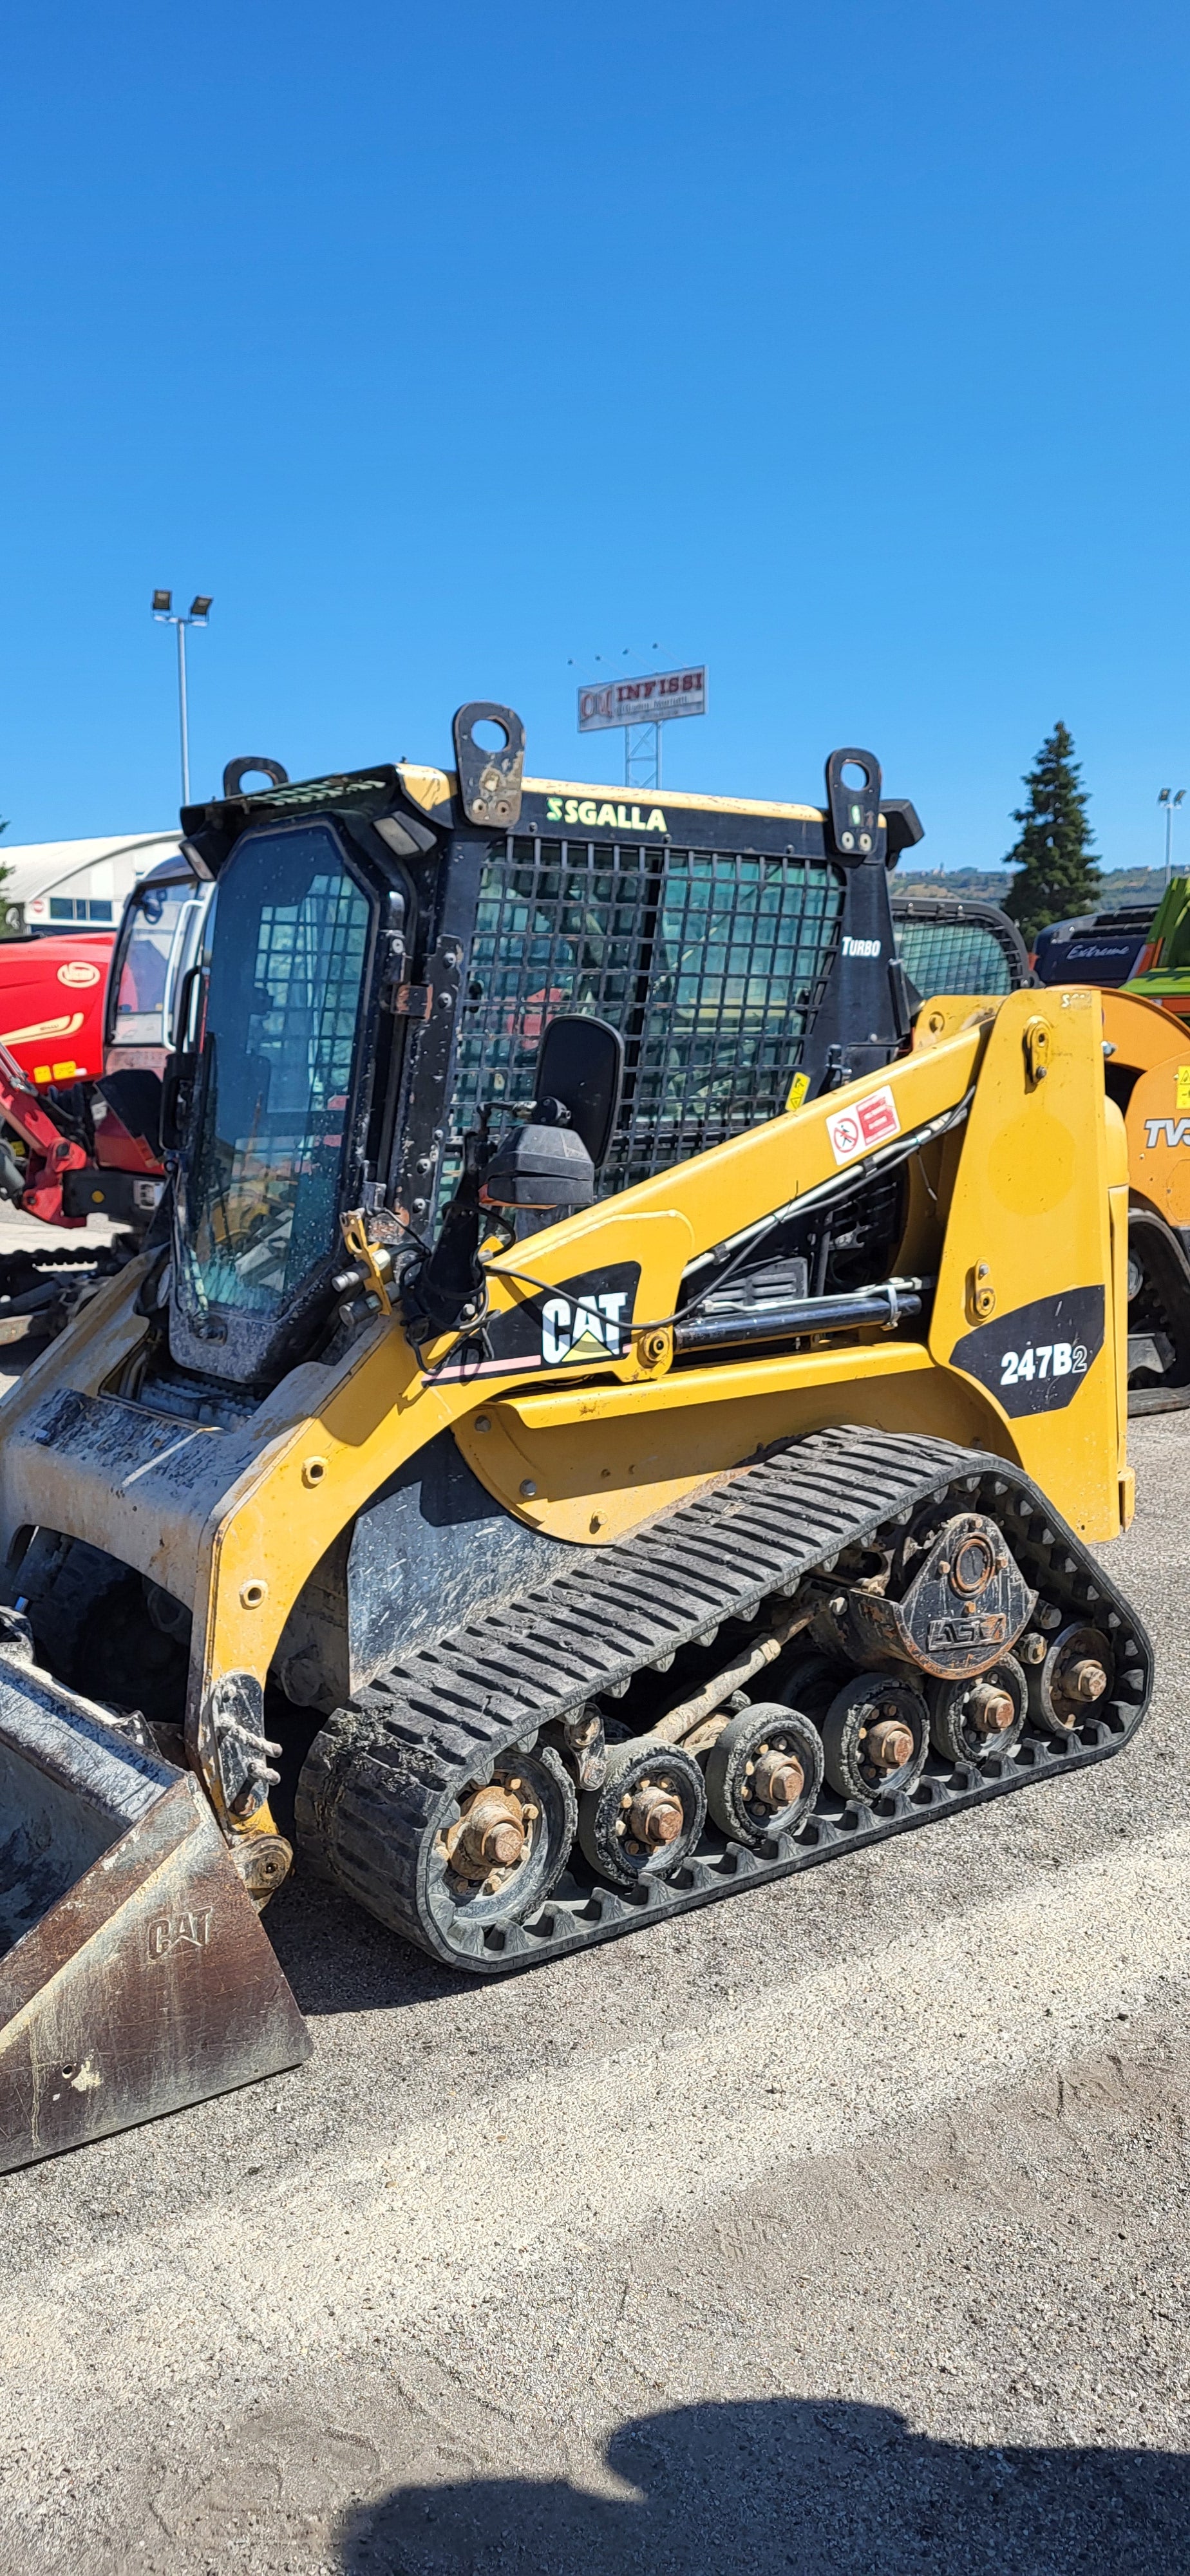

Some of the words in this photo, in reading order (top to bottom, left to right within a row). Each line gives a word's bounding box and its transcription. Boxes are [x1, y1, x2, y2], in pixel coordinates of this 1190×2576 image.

[617, 673, 703, 701] INFISSI
[1066, 944, 1129, 960] Extreme
[542, 1292, 628, 1364] CAT
[1000, 1342, 1088, 1385] 247B2
[147, 1906, 212, 1961] CAT
